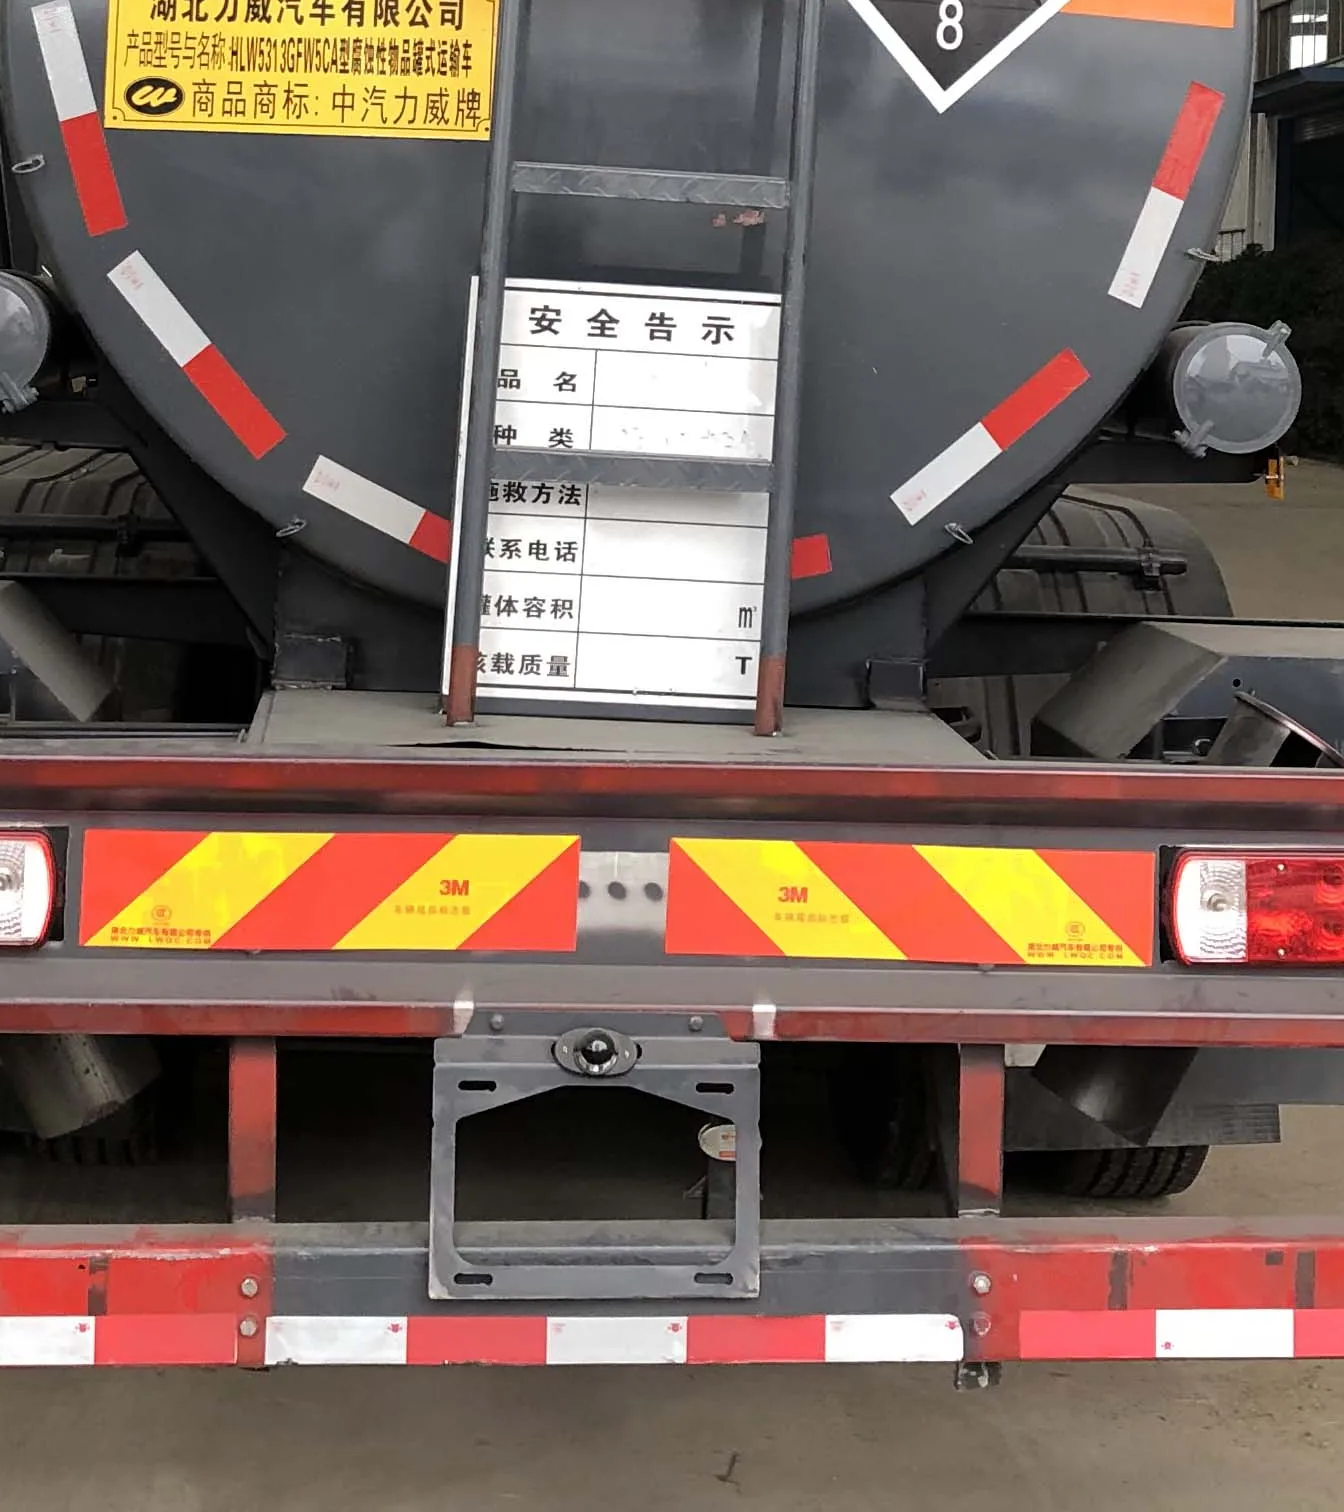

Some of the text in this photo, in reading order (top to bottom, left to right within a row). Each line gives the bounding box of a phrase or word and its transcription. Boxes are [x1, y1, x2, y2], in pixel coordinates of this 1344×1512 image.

[529, 306, 735, 345] 安全告示
[735, 656, 753, 675] T
[439, 879, 469, 896] 3M
[778, 886, 808, 903] 3M
